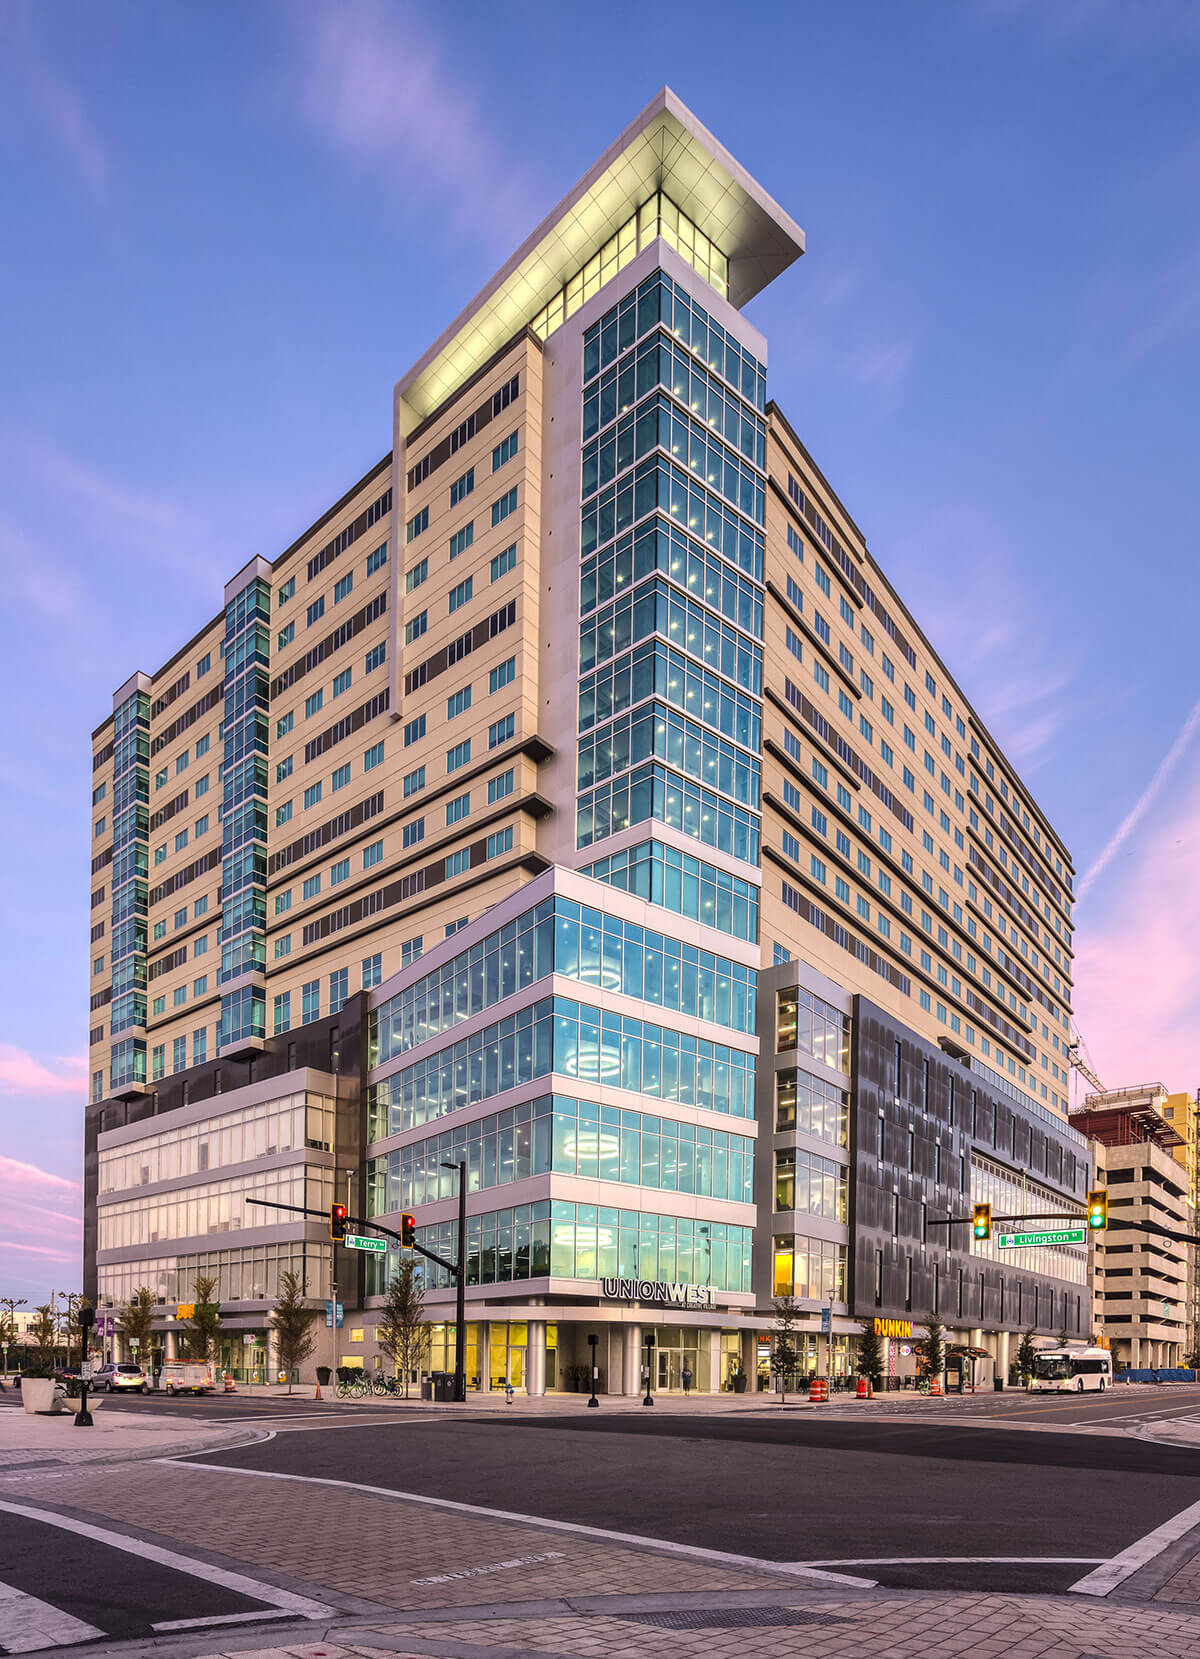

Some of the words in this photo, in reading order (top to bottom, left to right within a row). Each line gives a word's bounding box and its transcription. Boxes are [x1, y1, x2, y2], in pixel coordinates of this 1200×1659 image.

[359, 1239, 378, 1249] Terry
[1019, 1233, 1069, 1244] Livingston
[874, 1317, 914, 1338] DUNKIN'
